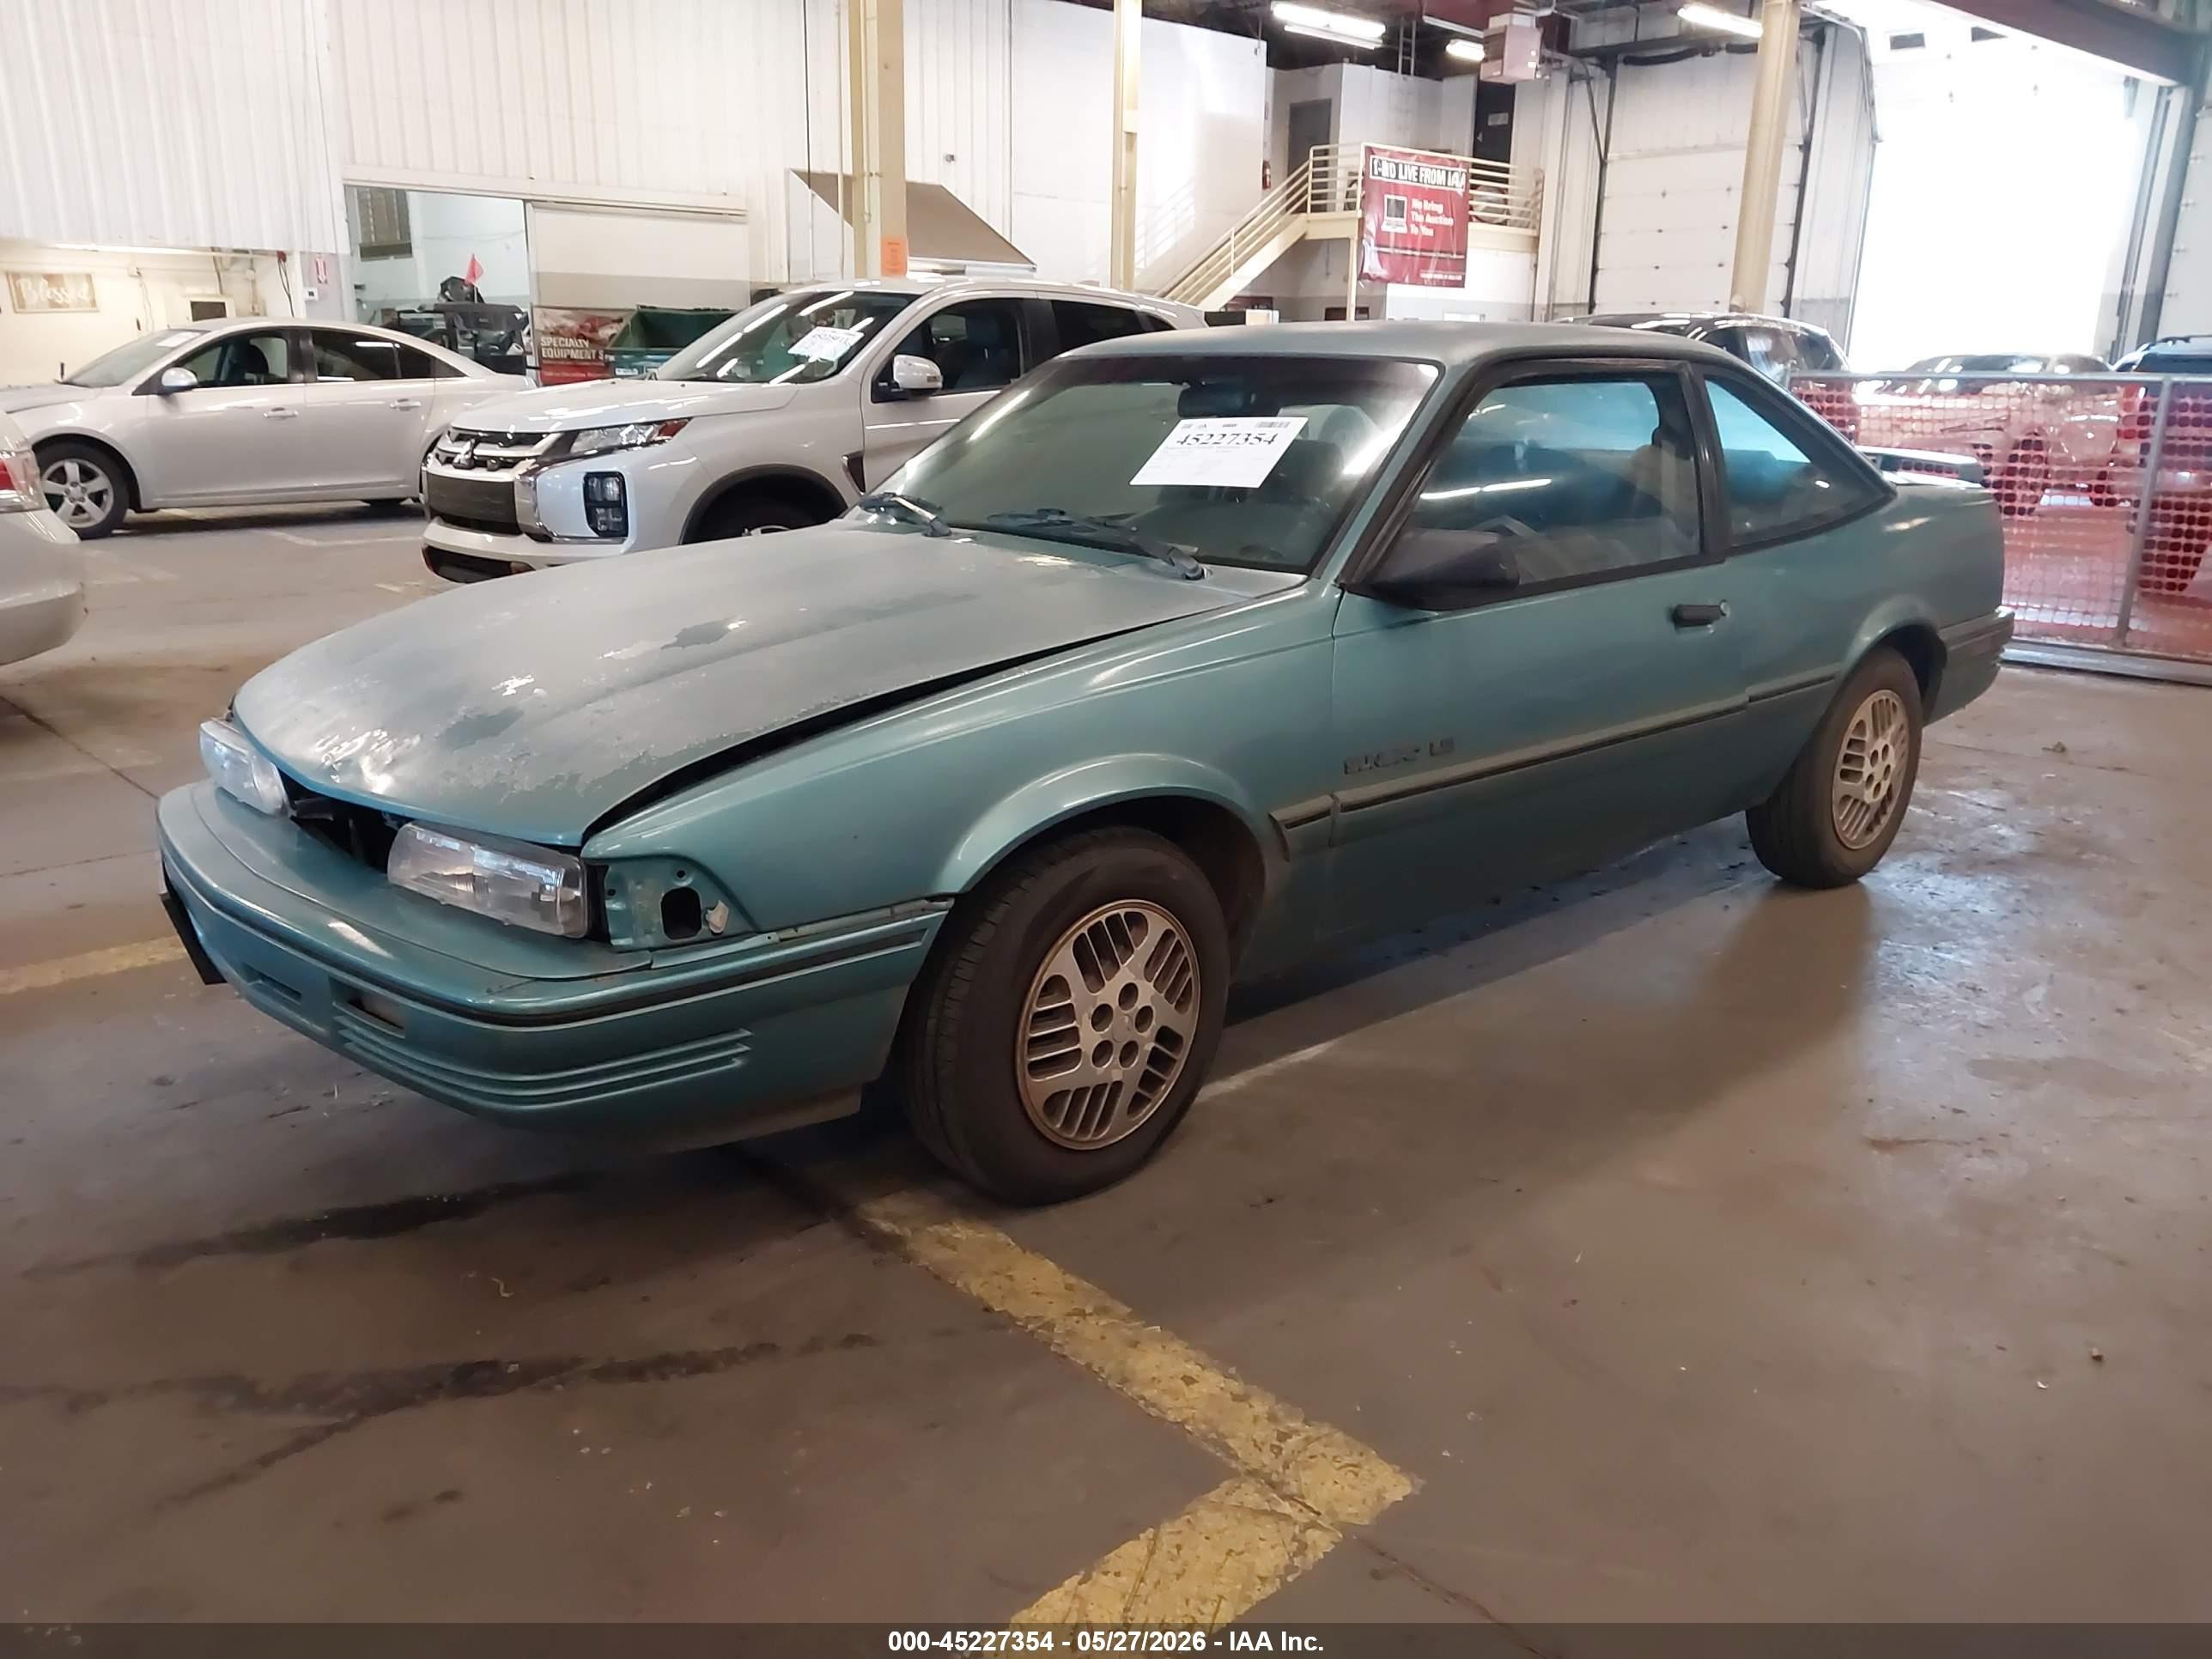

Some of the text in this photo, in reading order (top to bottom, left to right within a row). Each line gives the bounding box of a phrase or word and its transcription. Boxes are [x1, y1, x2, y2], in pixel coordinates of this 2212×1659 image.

[1398, 163, 1419, 182] LIVE
[1419, 167, 1446, 186] FROM
[540, 336, 590, 348] SPECIALTY
[541, 347, 597, 360] EQUIPMENT
[1176, 433, 1279, 445] 45227354
